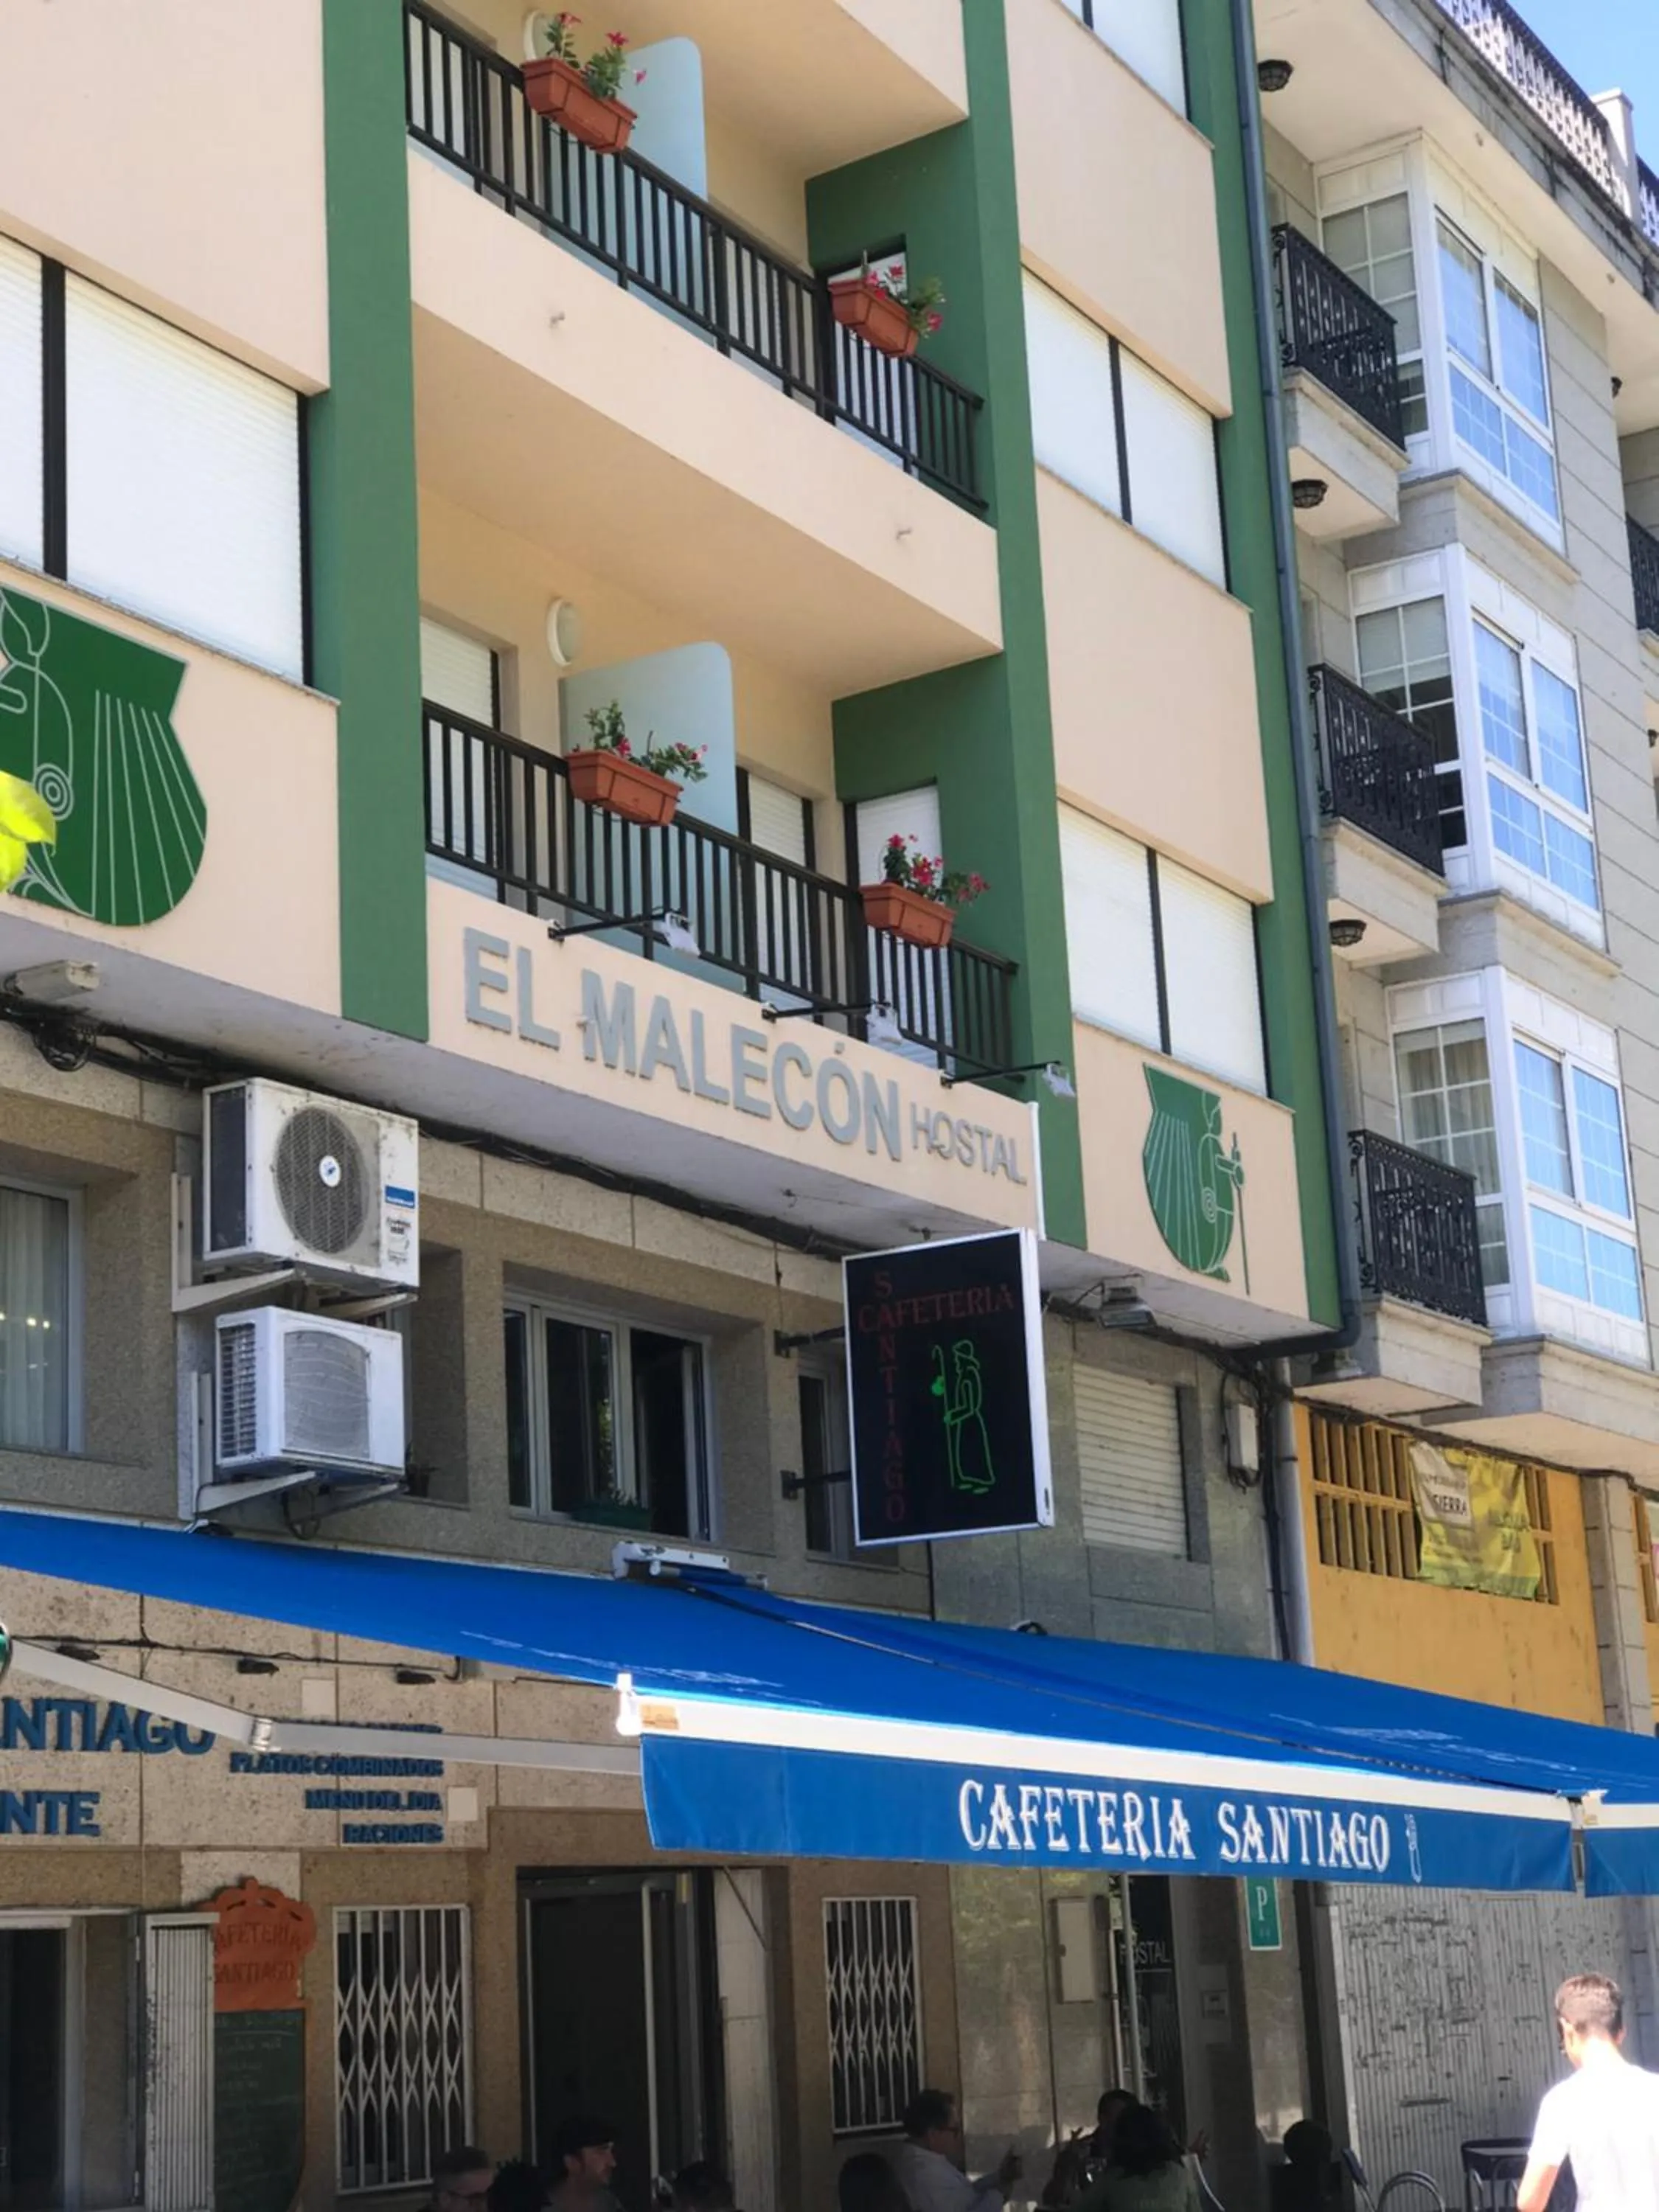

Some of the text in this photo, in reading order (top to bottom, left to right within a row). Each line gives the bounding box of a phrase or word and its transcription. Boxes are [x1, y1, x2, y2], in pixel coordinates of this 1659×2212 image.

[464, 927, 1028, 1186] EL MALECÓN HOSTAL
[857, 1283, 1016, 1333] CAFETERIA
[874, 1271, 907, 1523] SANTIAGO
[342, 1823, 444, 1844] RACIONES
[959, 1778, 1391, 1873] CAFETERIA SANTIAGO
[1255, 1885, 1268, 1921] P
